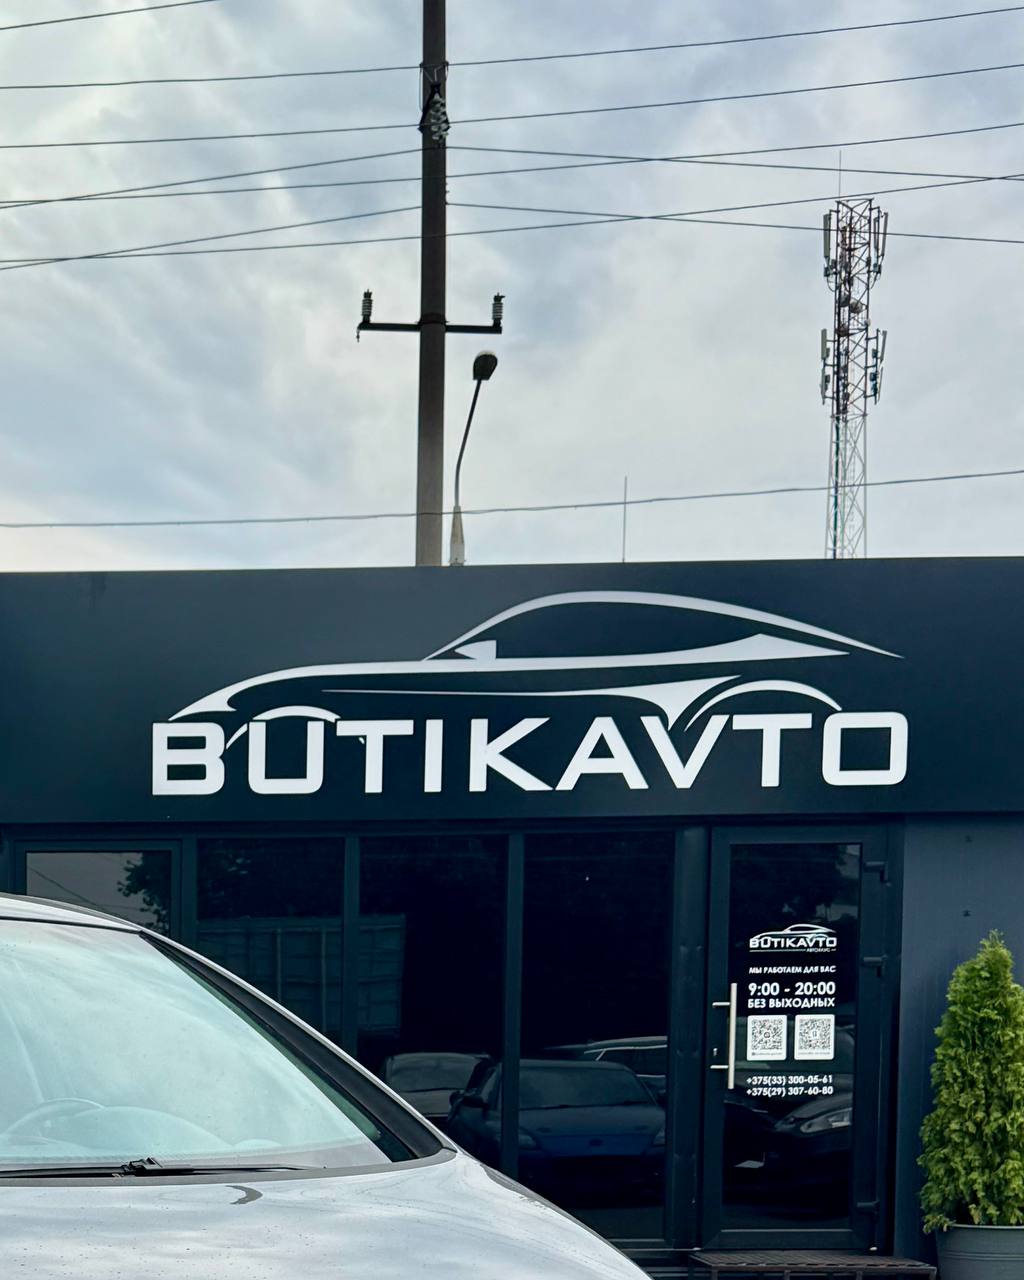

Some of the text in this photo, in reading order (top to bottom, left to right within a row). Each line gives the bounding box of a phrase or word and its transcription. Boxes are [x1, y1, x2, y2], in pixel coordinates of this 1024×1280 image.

[151, 710, 910, 797] BUTIKAVTO
[749, 936, 837, 949] BUTIKAVTO
[763, 966, 802, 974] РАБОТАЕМ
[803, 966, 819, 974] ДЛЯ
[820, 965, 837, 973] ВАС
[748, 982, 780, 996] 9:00
[795, 981, 836, 995] 20:00
[748, 997, 835, 1009] БЕЗ ВЫХОДНЫХ
[746, 1074, 833, 1086] +375(33) 300-05-61
[746, 1086, 834, 1097] +375(29) 307-60-80
